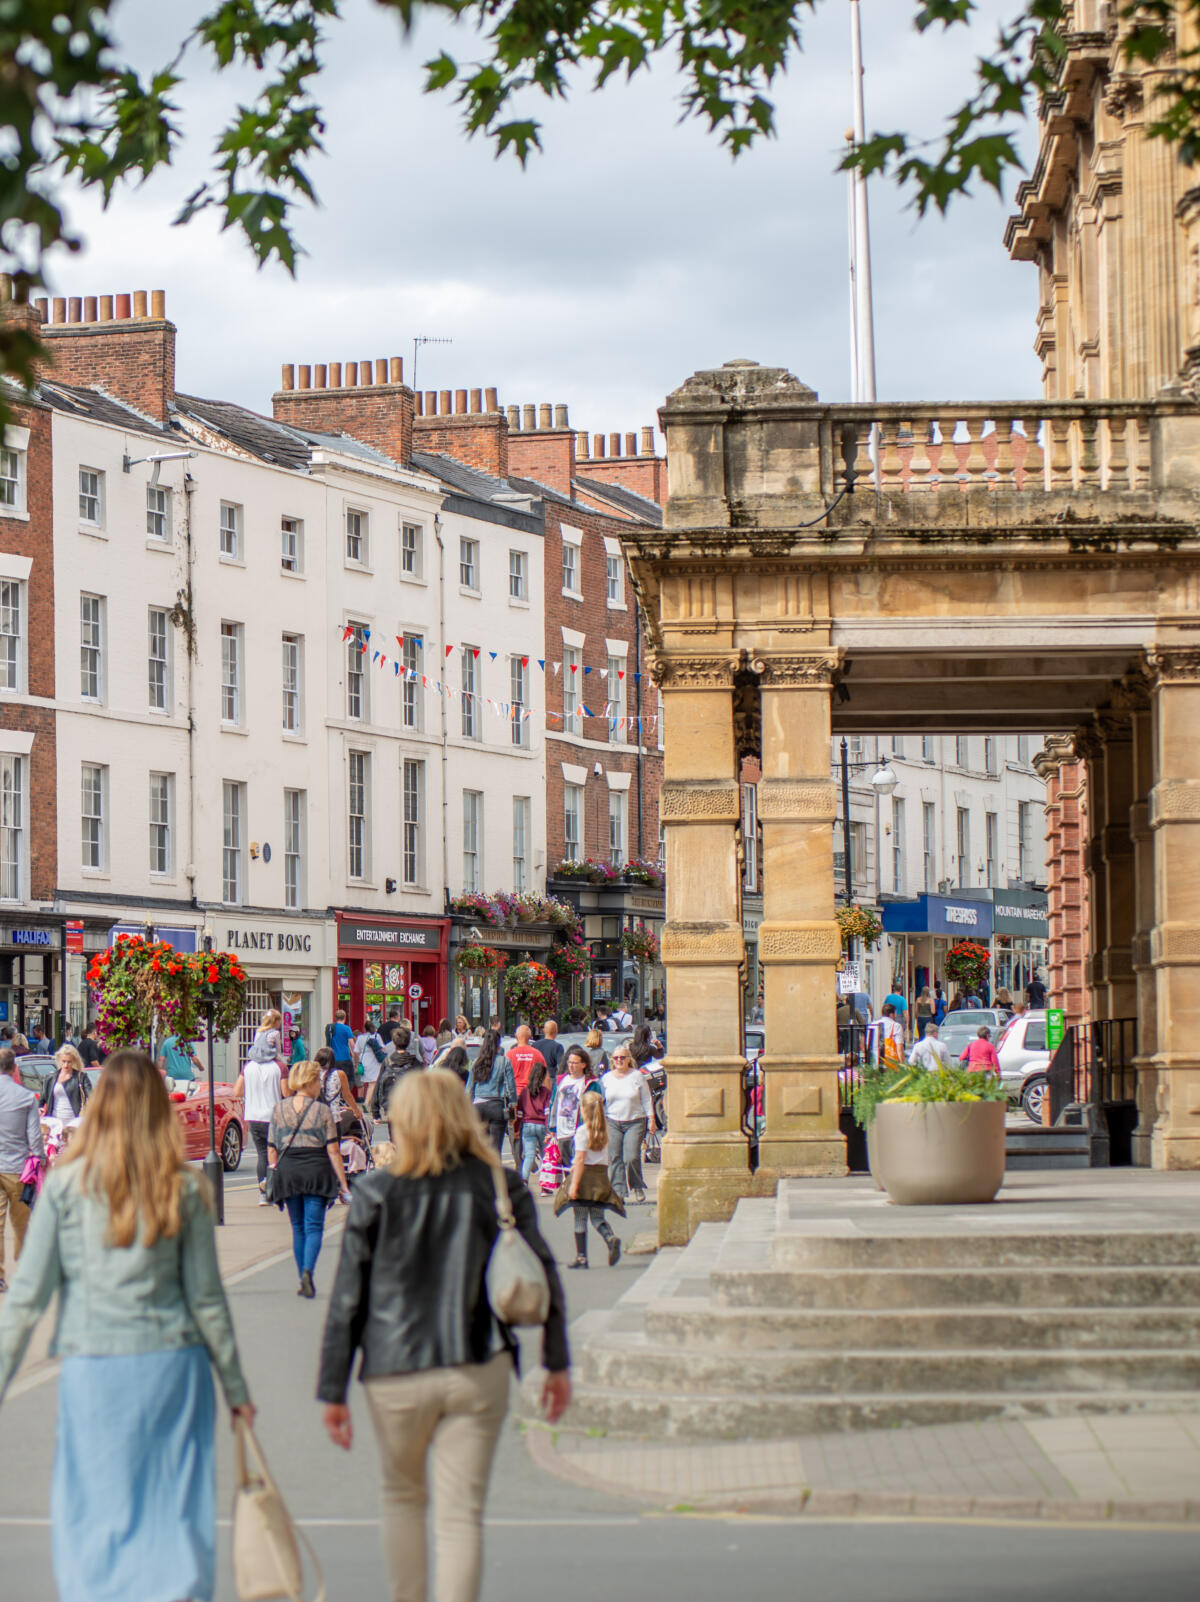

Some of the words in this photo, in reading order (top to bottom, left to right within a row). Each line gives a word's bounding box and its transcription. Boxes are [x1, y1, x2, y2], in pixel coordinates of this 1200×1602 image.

[945, 905, 978, 925] TRESPASS
[16, 930, 53, 945] HALIFAX
[227, 930, 273, 950] PLANET
[278, 933, 312, 952] BONG
[356, 929, 398, 943] ENTERTAINMENT
[400, 932, 426, 945] EXCHANGE
